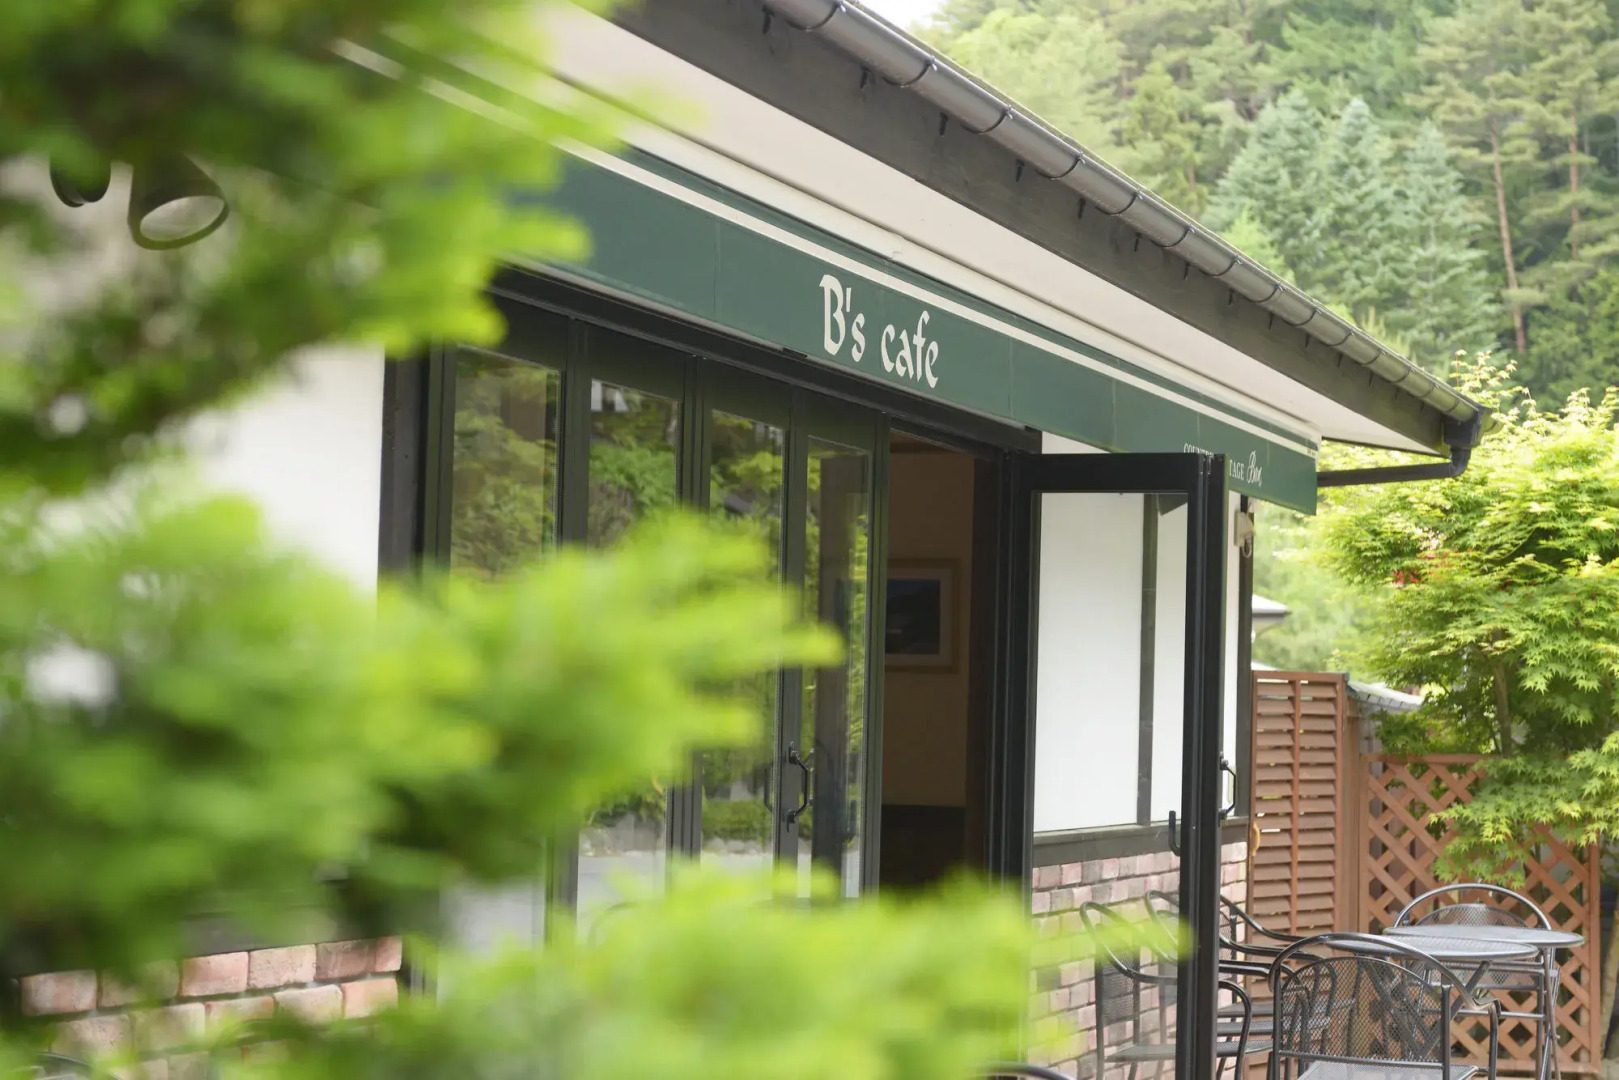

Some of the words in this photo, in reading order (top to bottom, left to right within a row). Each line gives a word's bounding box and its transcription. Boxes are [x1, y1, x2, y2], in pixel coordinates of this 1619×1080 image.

[819, 274, 866, 362] B's
[880, 310, 939, 389] cafe
[1229, 459, 1244, 481] TAGE
